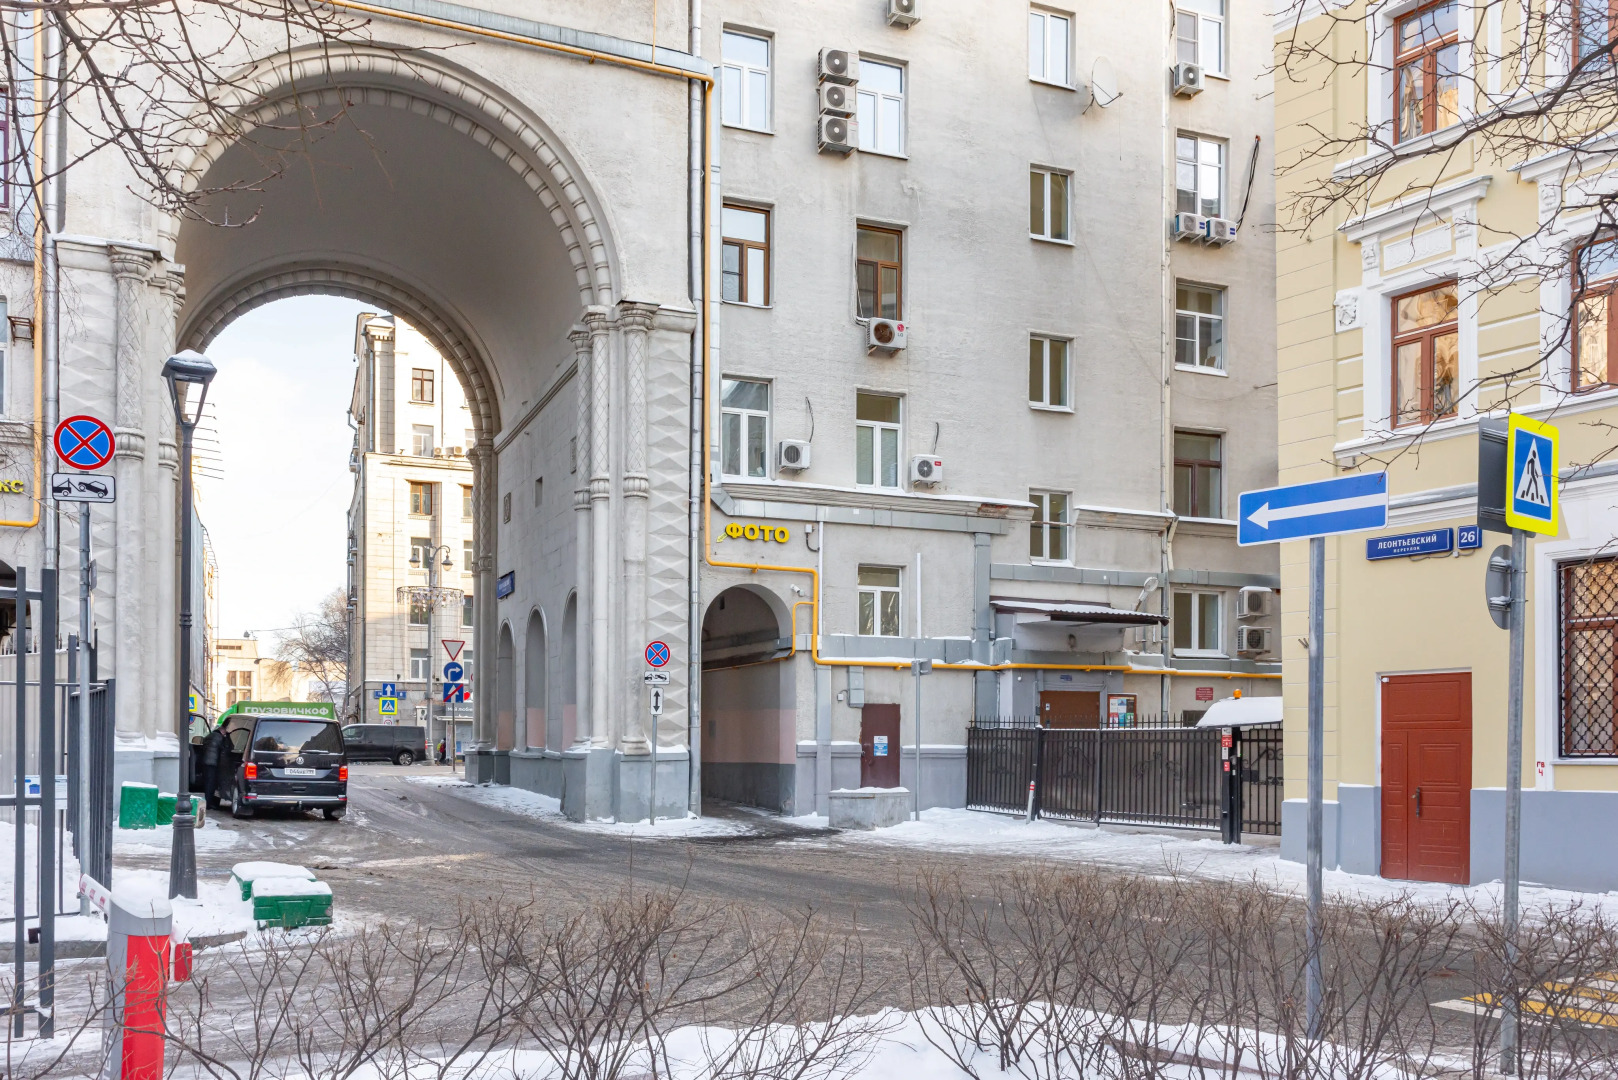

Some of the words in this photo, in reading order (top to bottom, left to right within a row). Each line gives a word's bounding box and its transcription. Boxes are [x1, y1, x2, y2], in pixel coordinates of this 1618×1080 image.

[725, 522, 790, 543] ФОТО
[1460, 530, 1476, 543] 26
[1377, 533, 1437, 550] ЛЕОНТЬЕВСКИЙ
[244, 706, 329, 715] ГРУЗОВИЧКОФ
